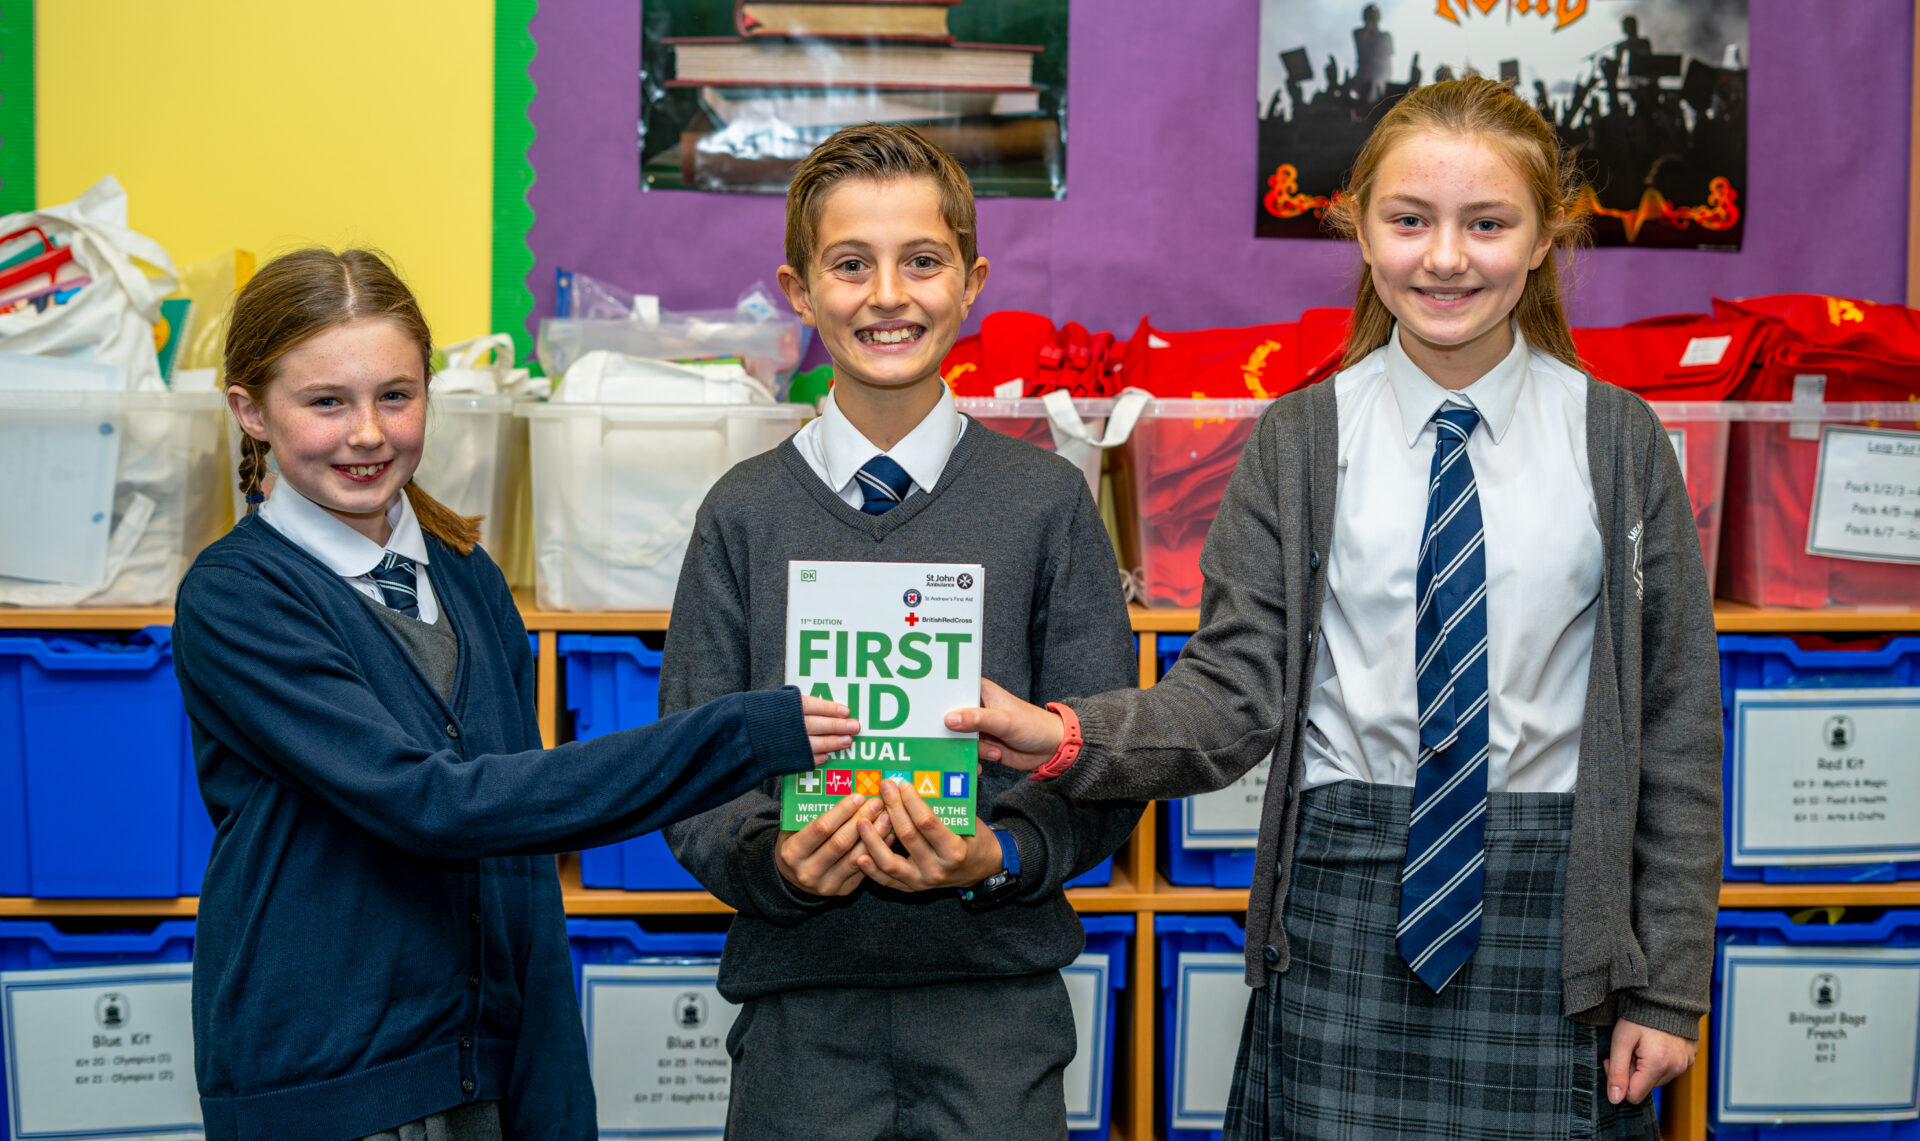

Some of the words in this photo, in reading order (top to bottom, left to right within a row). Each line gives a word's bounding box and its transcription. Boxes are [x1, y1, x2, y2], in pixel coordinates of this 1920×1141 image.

[1845, 480, 1870, 493] Pack
[1852, 502, 1877, 515] Pack
[1845, 522, 1871, 536] Pack
[926, 574, 934, 582] St
[936, 574, 955, 582] John
[813, 618, 842, 626] EDITION
[922, 616, 973, 624] BritishRedCross
[799, 630, 973, 680] FIRST
[1817, 757, 1842, 770] Red
[1846, 757, 1864, 770] Kit
[798, 803, 836, 812] WRITTE
[933, 806, 946, 815] BY
[947, 806, 968, 816] THE
[1789, 1011, 1836, 1027] Bilingual
[1840, 1011, 1866, 1028] Bags
[93, 1034, 122, 1048] Blue
[131, 1032, 151, 1046] Kit
[1807, 1027, 1847, 1040] French
[667, 1036, 696, 1050] Blue
[700, 1036, 719, 1049] Kit
[76, 1058, 89, 1067] Kit
[76, 1076, 89, 1085] Kit
